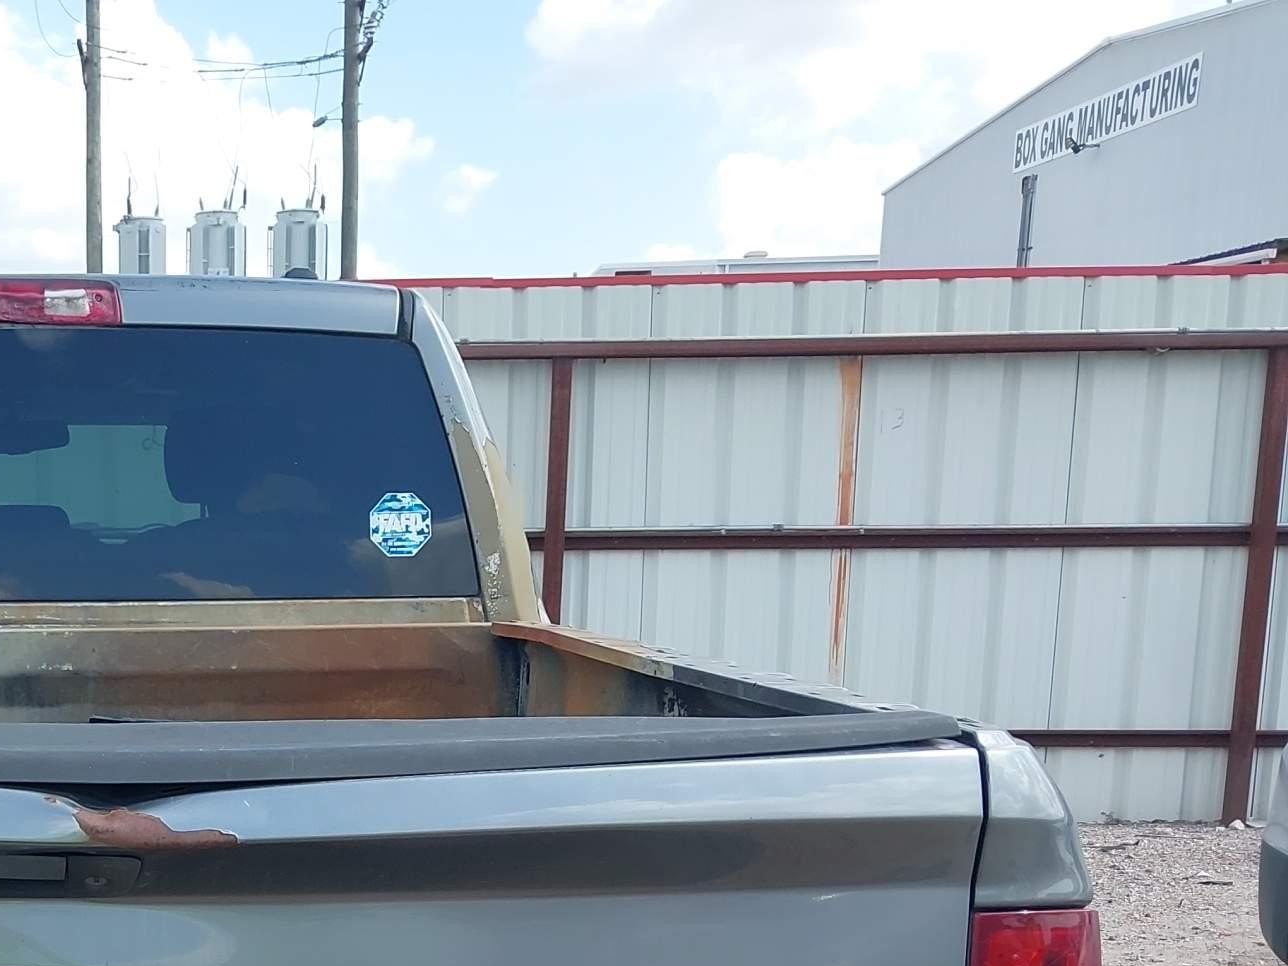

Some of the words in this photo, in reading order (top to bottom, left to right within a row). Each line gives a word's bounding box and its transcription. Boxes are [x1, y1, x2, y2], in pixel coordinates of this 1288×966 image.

[1014, 125, 1039, 169] BOX
[1040, 111, 1074, 160] GANG
[1076, 57, 1200, 144] MANUFACTURING
